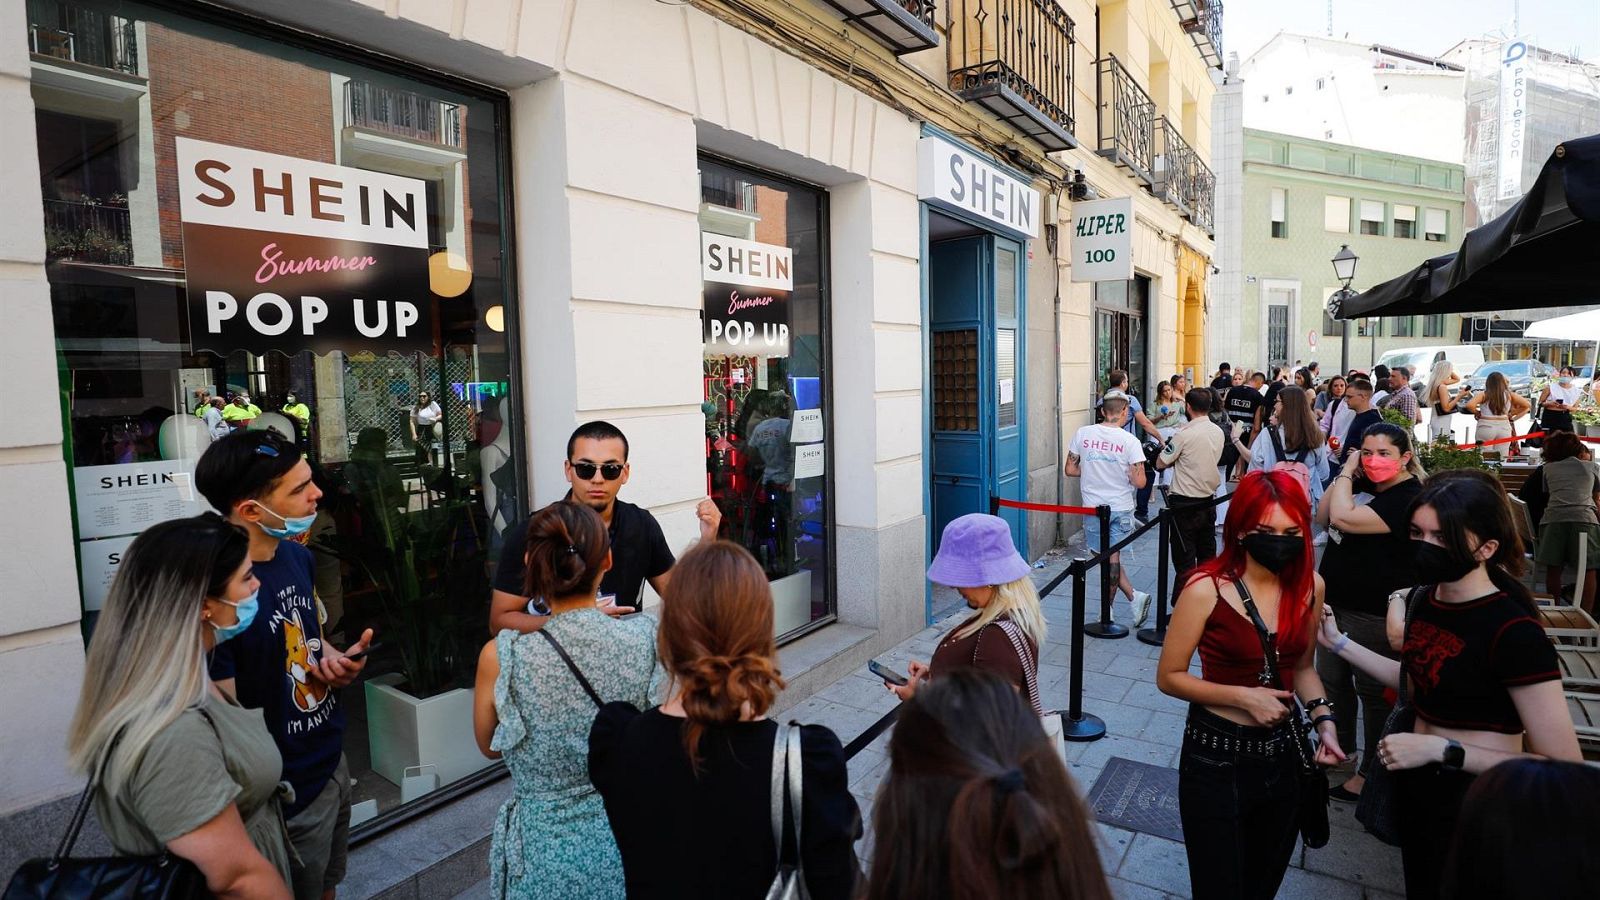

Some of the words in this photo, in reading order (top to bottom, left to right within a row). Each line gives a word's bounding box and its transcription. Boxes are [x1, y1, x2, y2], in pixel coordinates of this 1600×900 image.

[194, 159, 416, 232] SHEIN
[949, 153, 1031, 229] SHEIN
[1076, 213, 1126, 237] HIPER
[254, 242, 376, 284] Summer
[708, 243, 789, 281] SHEIN
[1085, 248, 1116, 264] 100
[205, 290, 329, 336] POP
[352, 298, 419, 338] UP
[727, 290, 774, 315] Summer
[710, 318, 755, 346] POP
[763, 322, 789, 346] UP
[800, 414, 819, 422] SHEIN
[802, 450, 821, 458] SHEIN
[1083, 439, 1124, 453] SHEIN
[101, 472, 174, 489] SHEIN
[287, 719, 303, 735] I'M
